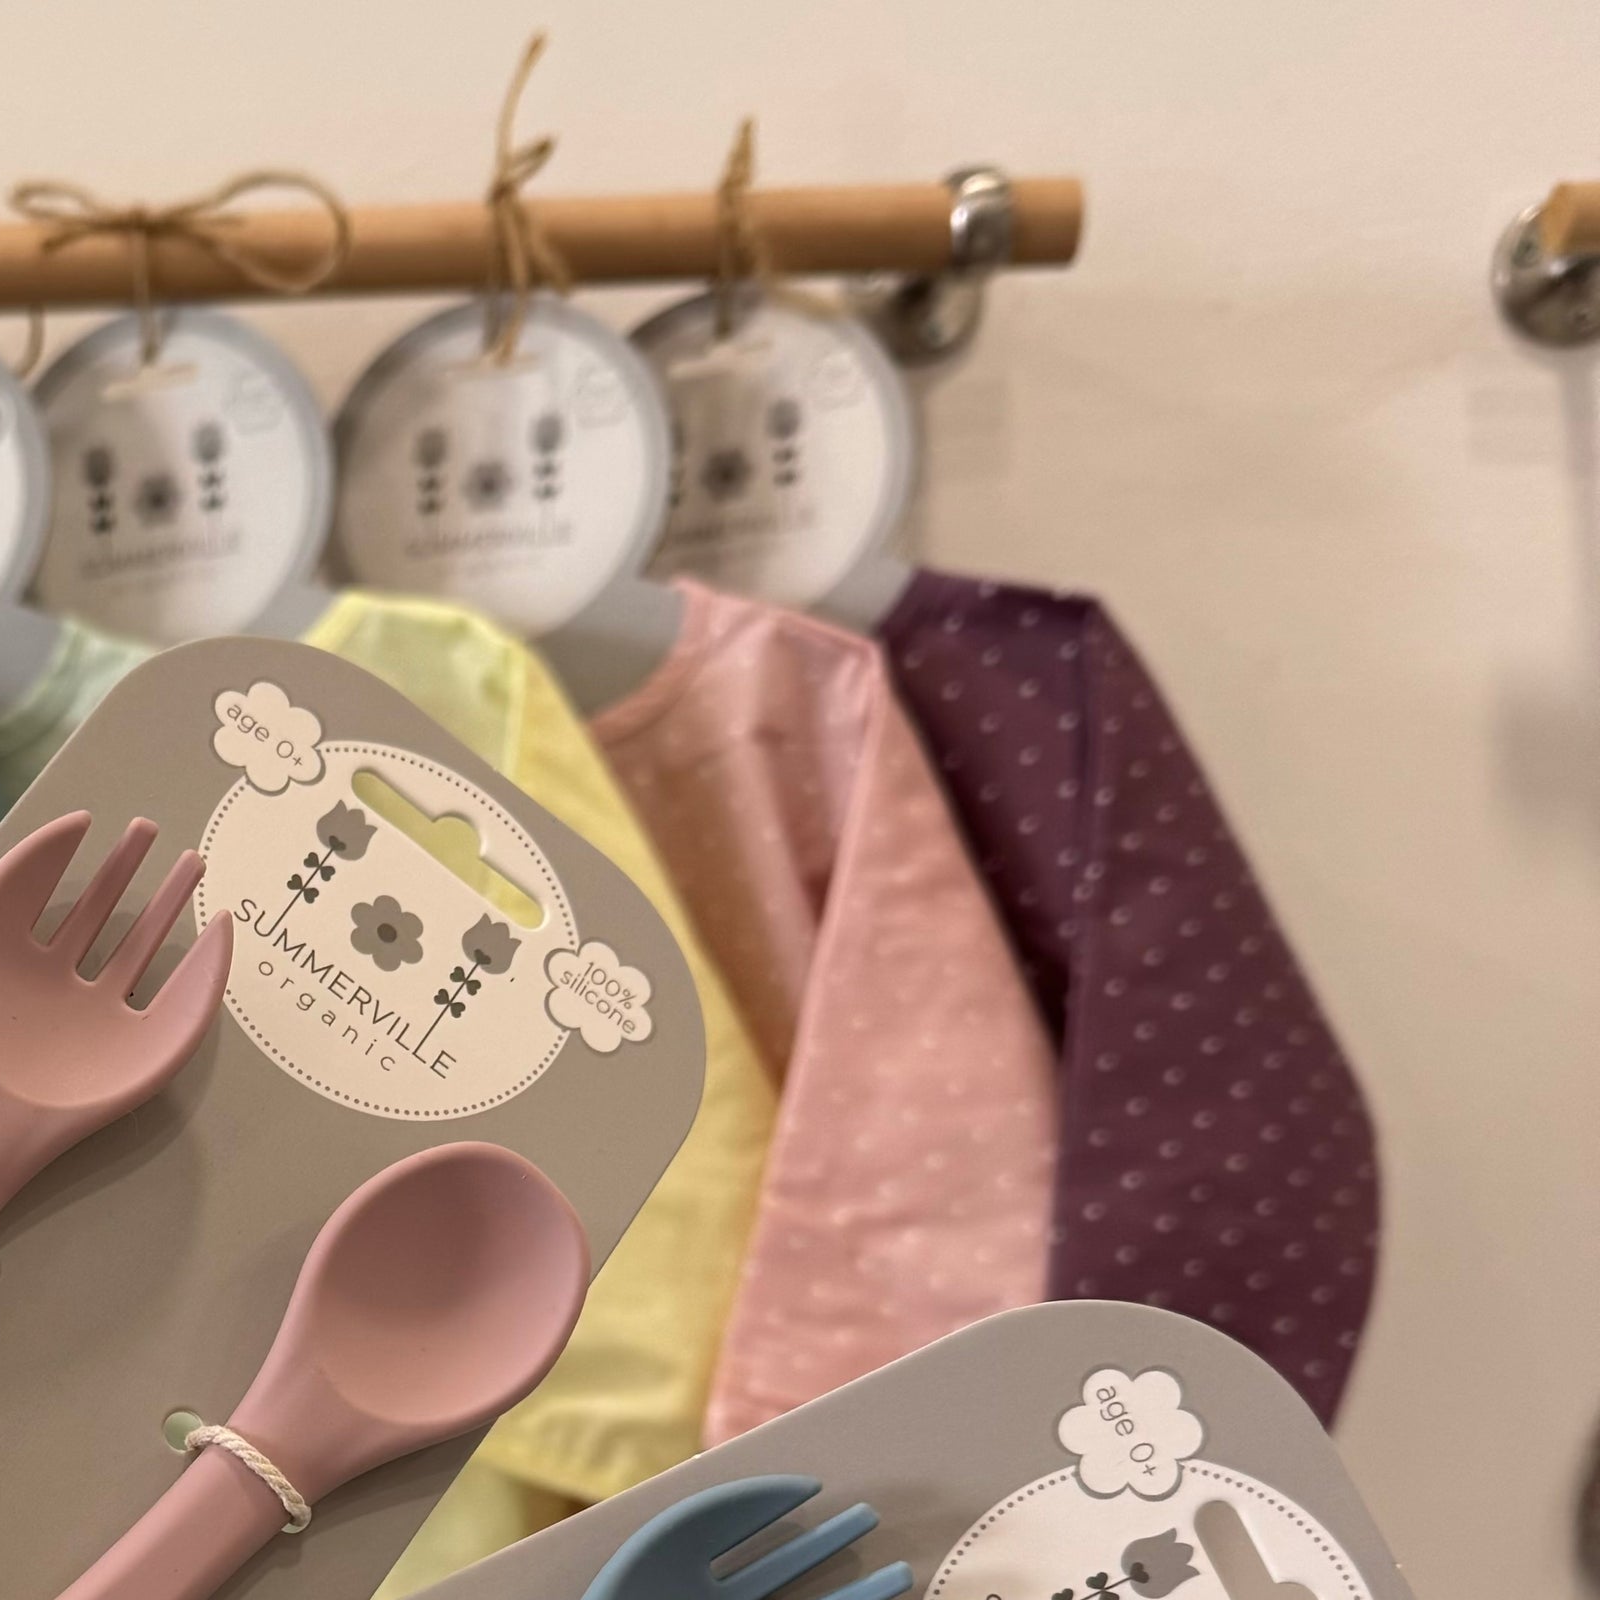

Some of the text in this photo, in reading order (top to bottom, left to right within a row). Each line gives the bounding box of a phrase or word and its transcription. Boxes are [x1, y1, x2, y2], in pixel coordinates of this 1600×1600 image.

[225, 701, 303, 767] age 0+
[232, 897, 459, 1080] SUMMERVILLE
[256, 958, 398, 1074] organic
[558, 967, 638, 1036] silicone
[584, 960, 640, 1012] 100%
[1095, 1383, 1158, 1478] age 0+
